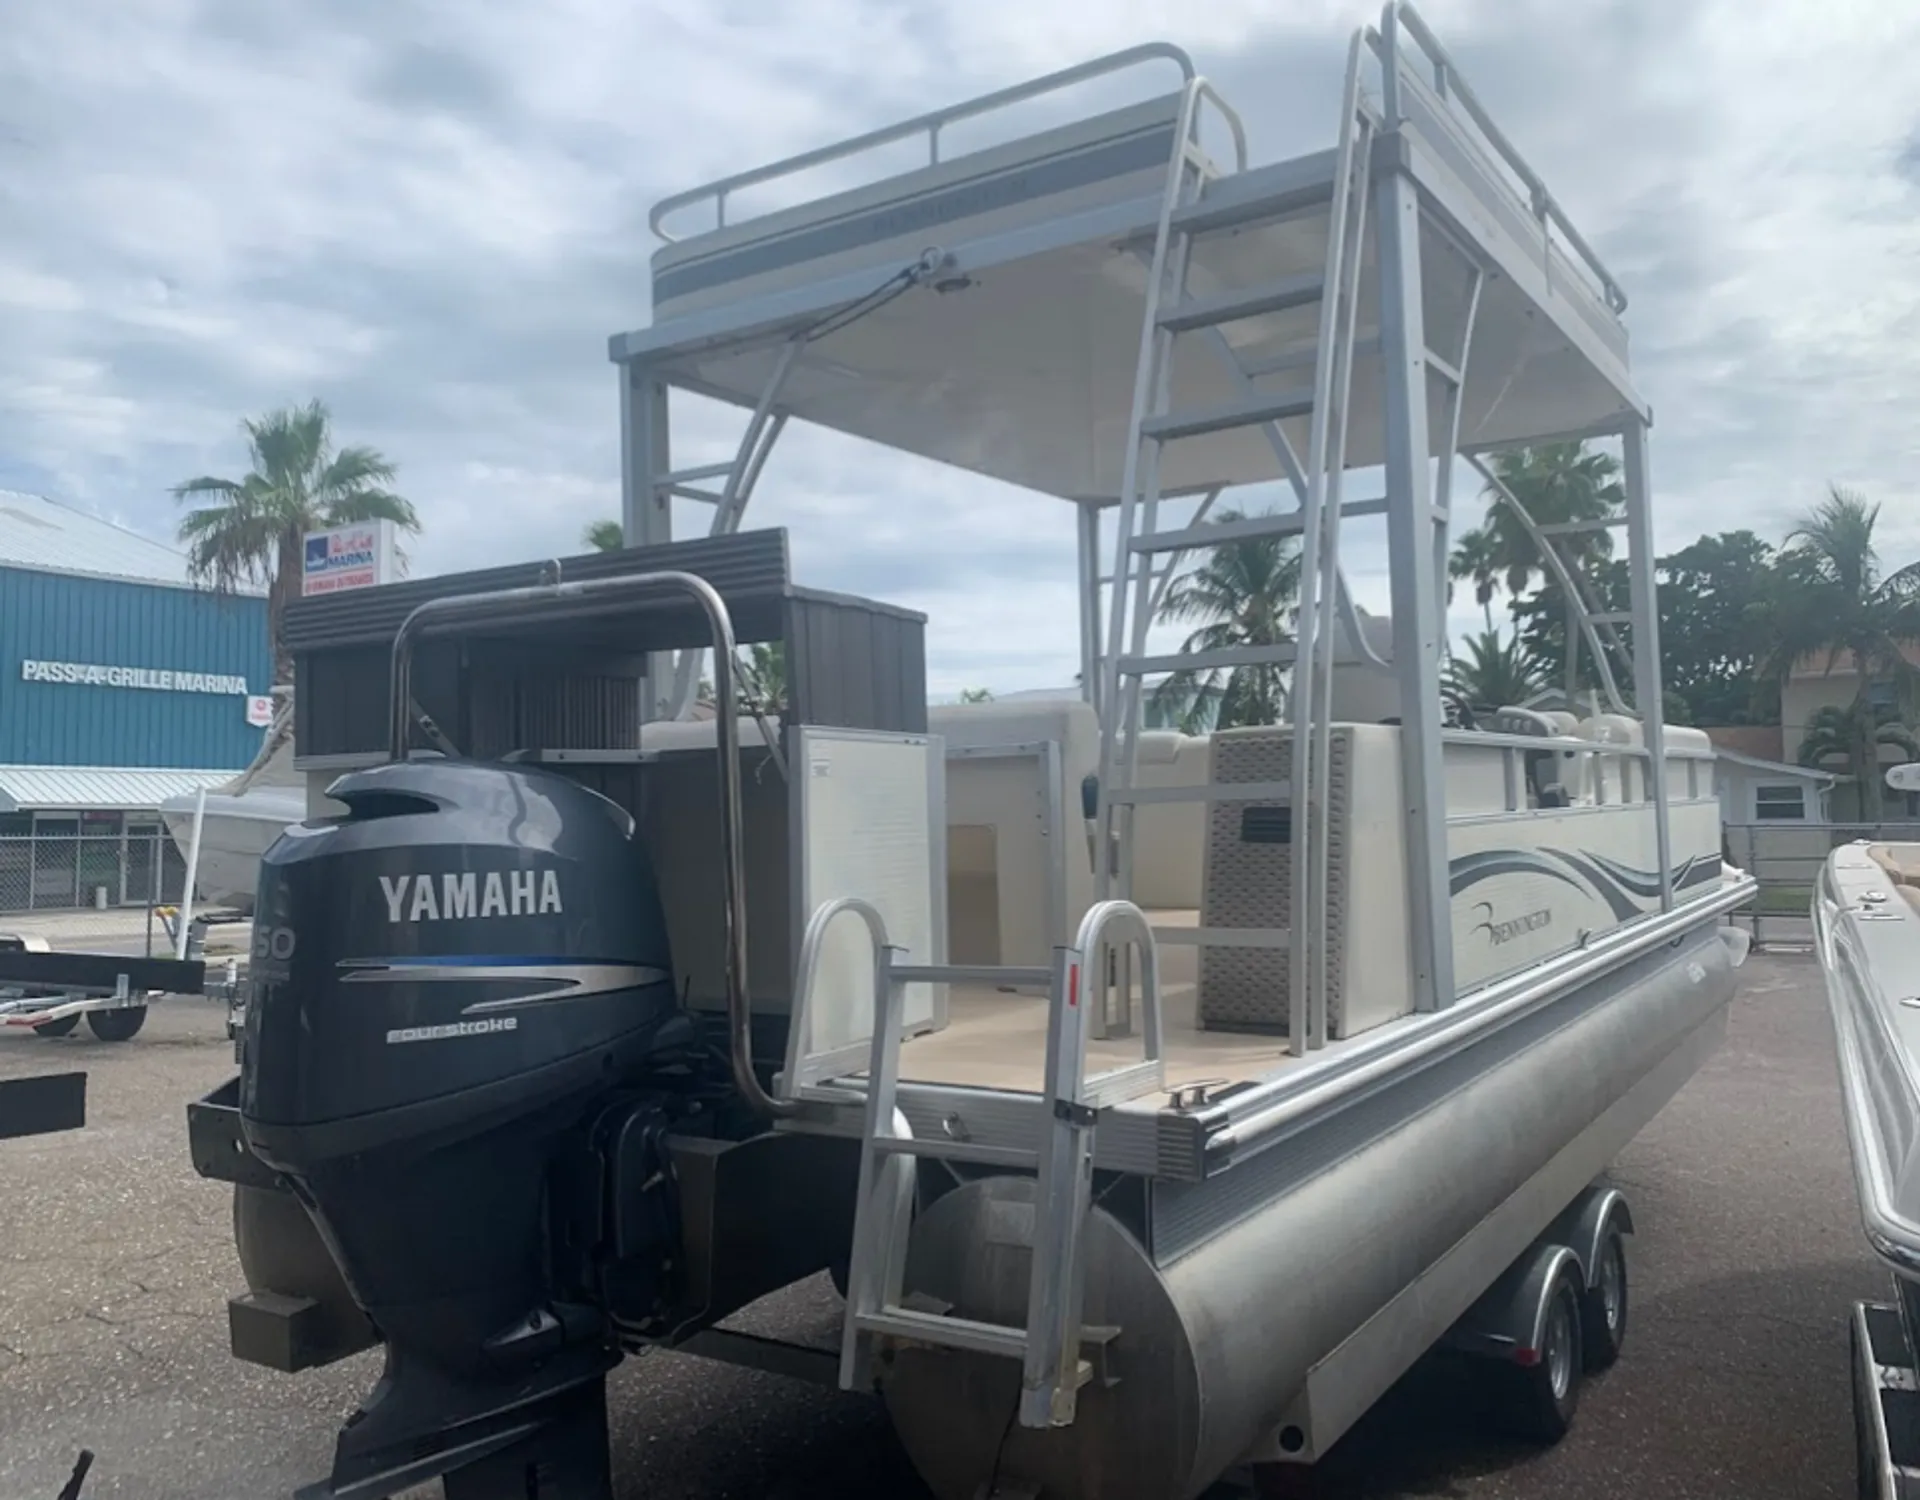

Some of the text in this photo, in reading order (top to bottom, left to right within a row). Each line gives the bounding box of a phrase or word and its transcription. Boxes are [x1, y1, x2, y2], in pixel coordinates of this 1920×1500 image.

[327, 551, 373, 567] MARINA
[22, 659, 248, 695] PASS-A-GRILLE MARINA
[378, 870, 563, 923] YAMAHA
